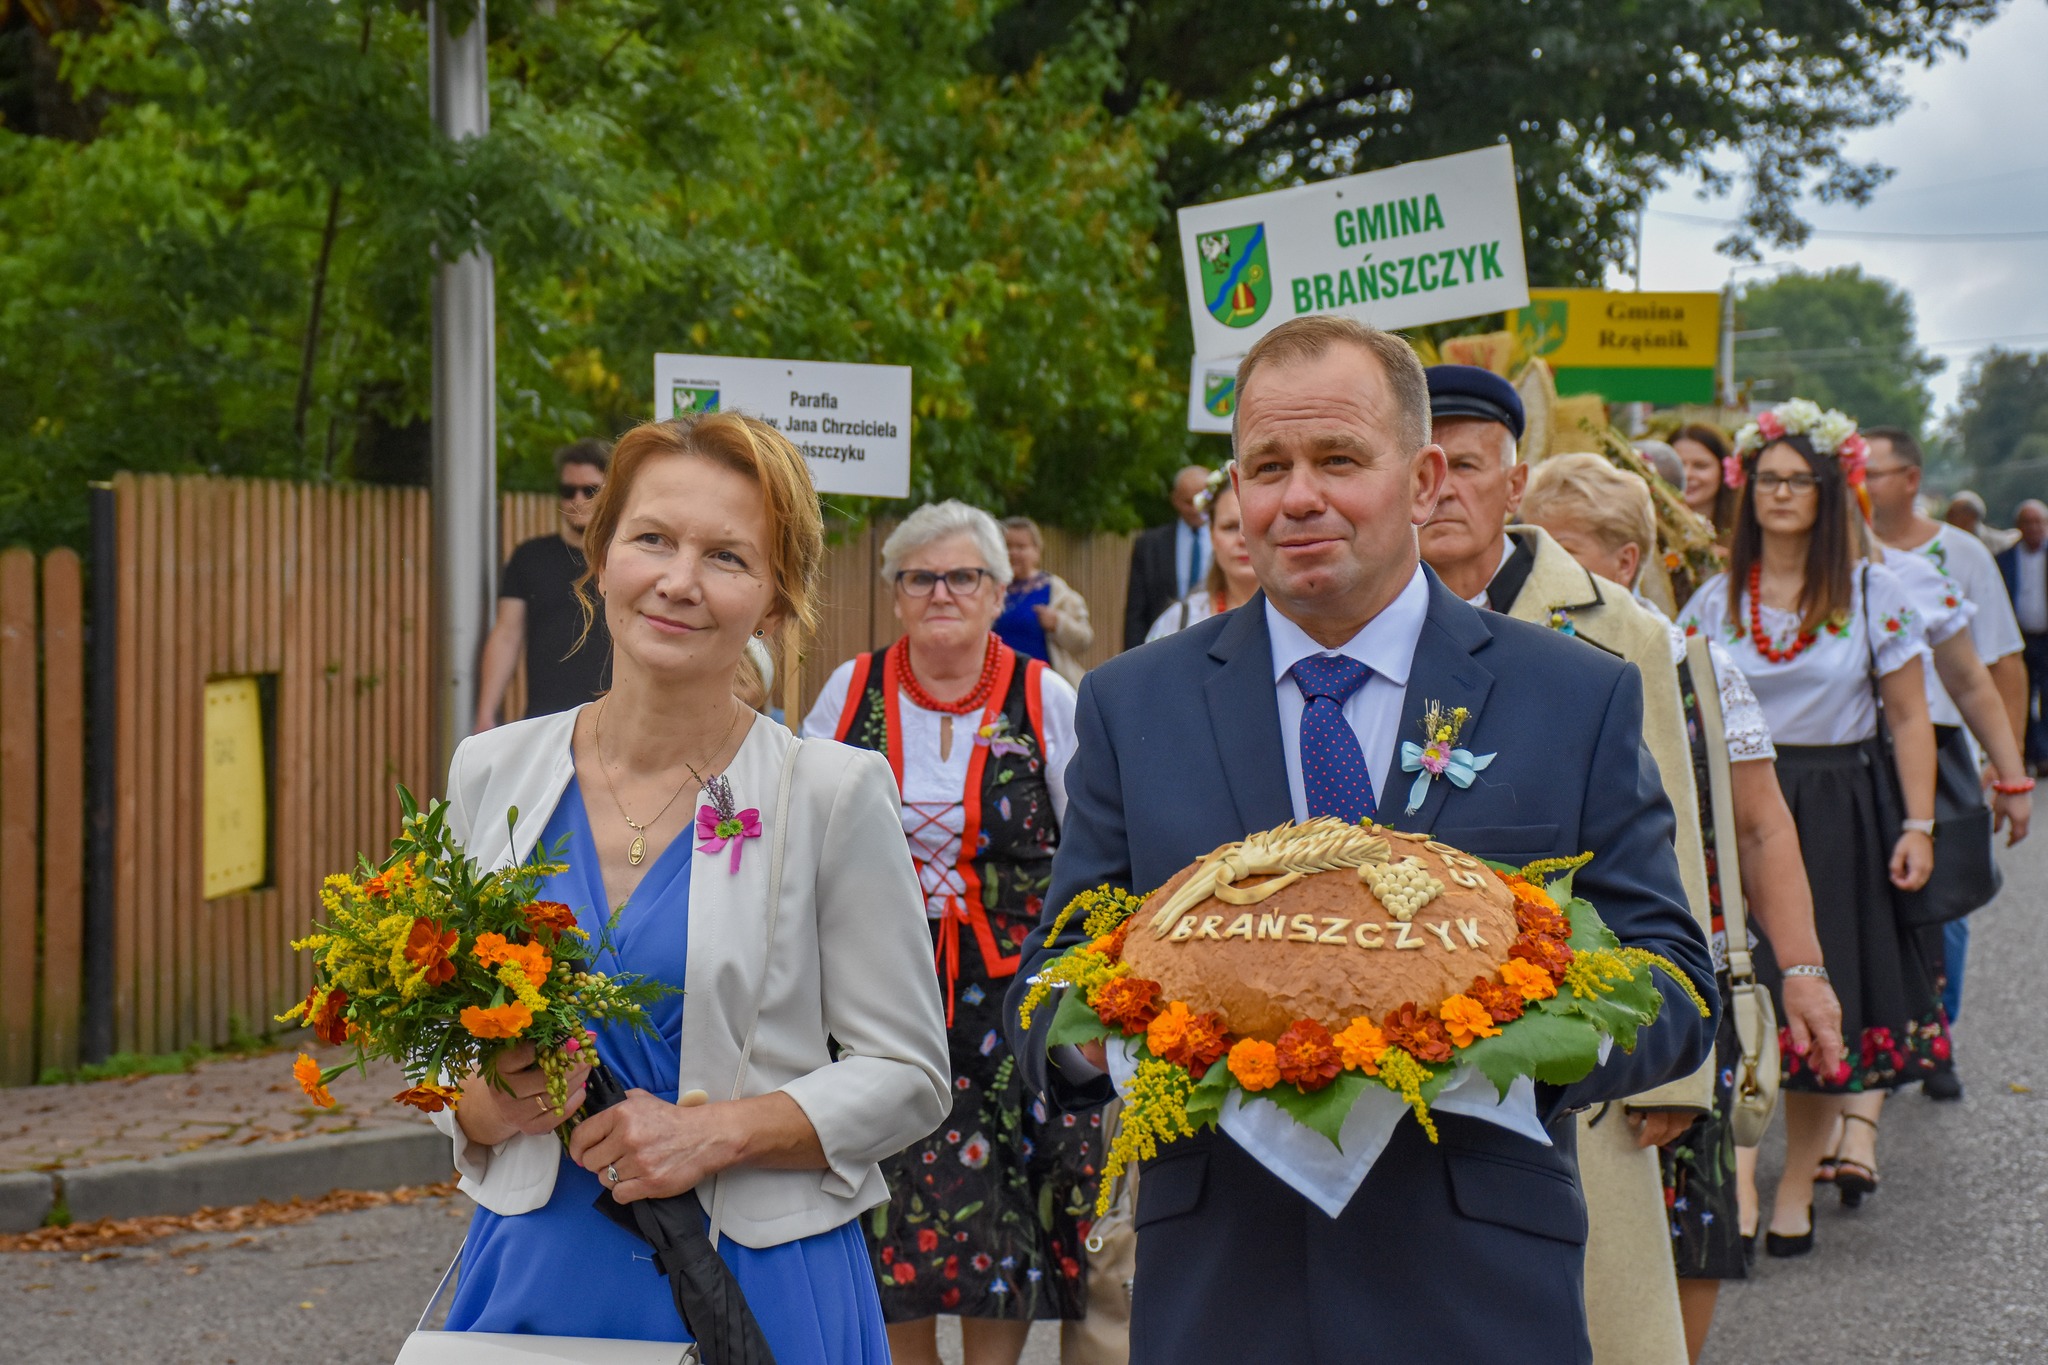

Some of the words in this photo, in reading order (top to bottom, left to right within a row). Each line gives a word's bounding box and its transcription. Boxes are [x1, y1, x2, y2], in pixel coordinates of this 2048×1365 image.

[1334, 193, 1445, 248] GMINA
[1291, 240, 1504, 314] BRAŃSZCZYK
[1606, 301, 1684, 320] Gmina
[790, 391, 838, 409] Parafia
[785, 416, 817, 432] Jana
[822, 418, 897, 437] Chrzciciela
[798, 441, 865, 462] ńszczyku
[1169, 907, 1489, 952] BRAŃSZCZYK
